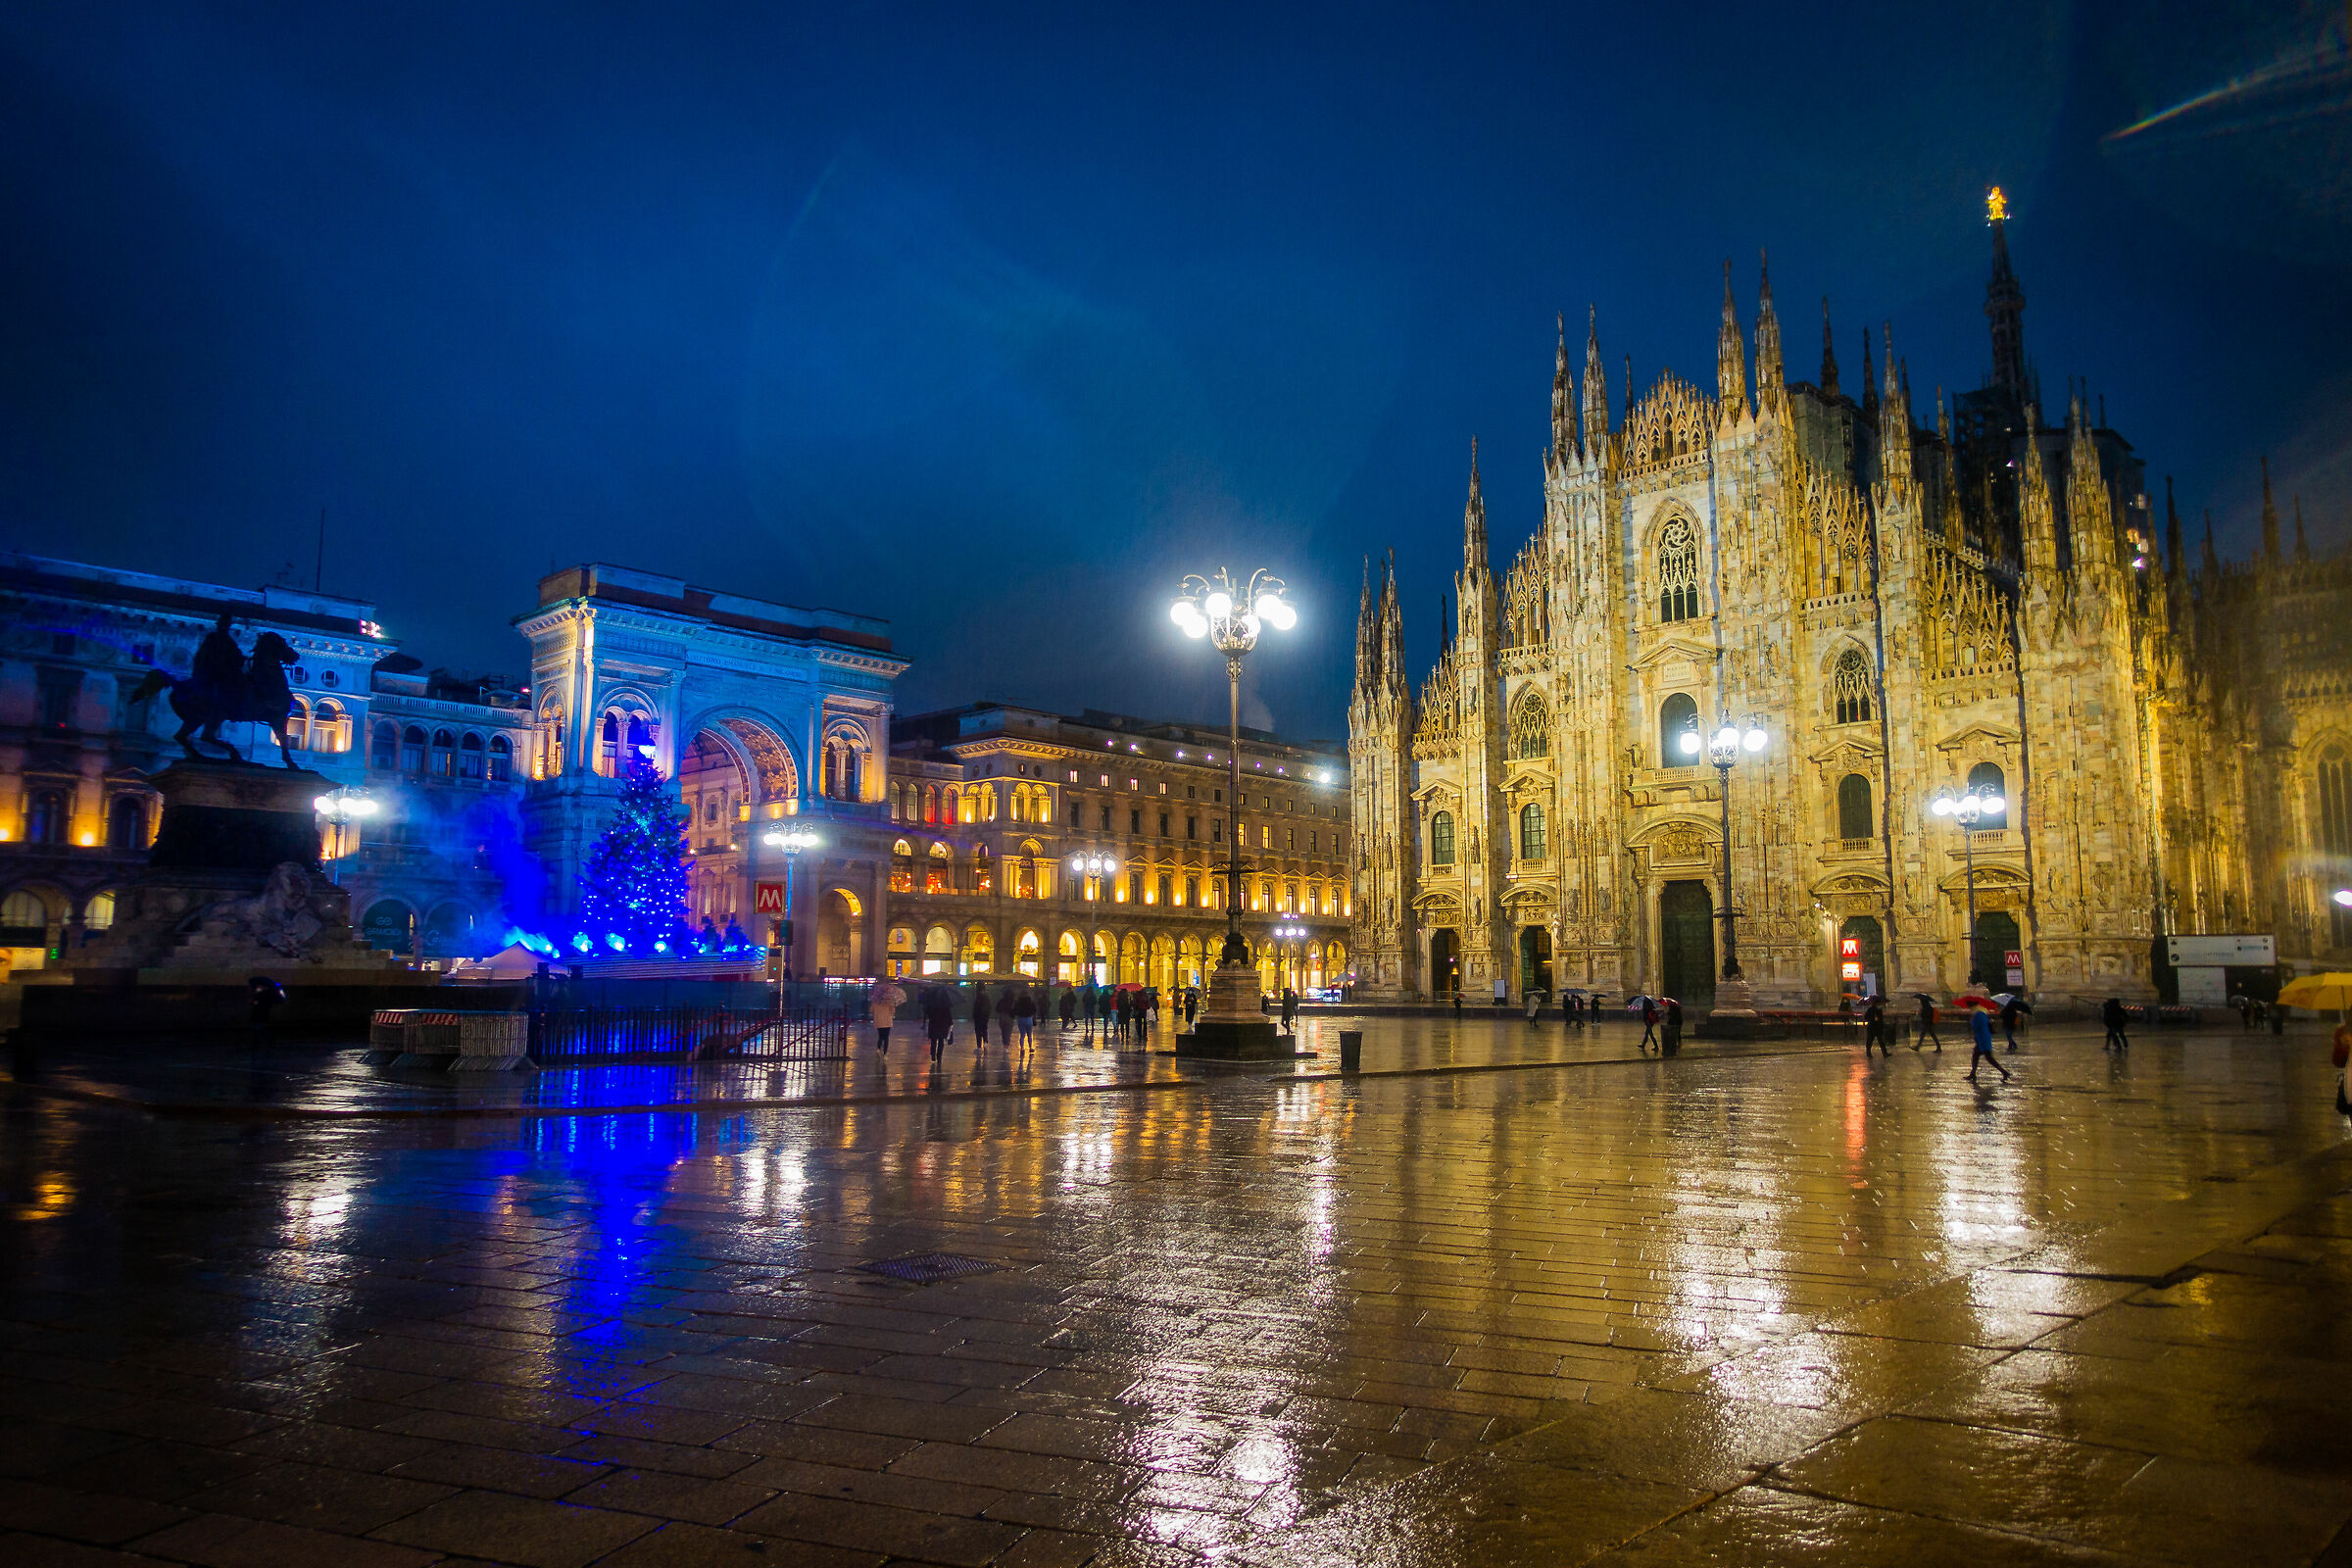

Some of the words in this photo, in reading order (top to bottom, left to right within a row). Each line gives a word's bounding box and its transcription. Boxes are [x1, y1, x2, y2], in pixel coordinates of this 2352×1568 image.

[759, 889, 781, 907] M
[1842, 940, 1857, 955] M
[2007, 955, 2020, 963] M
